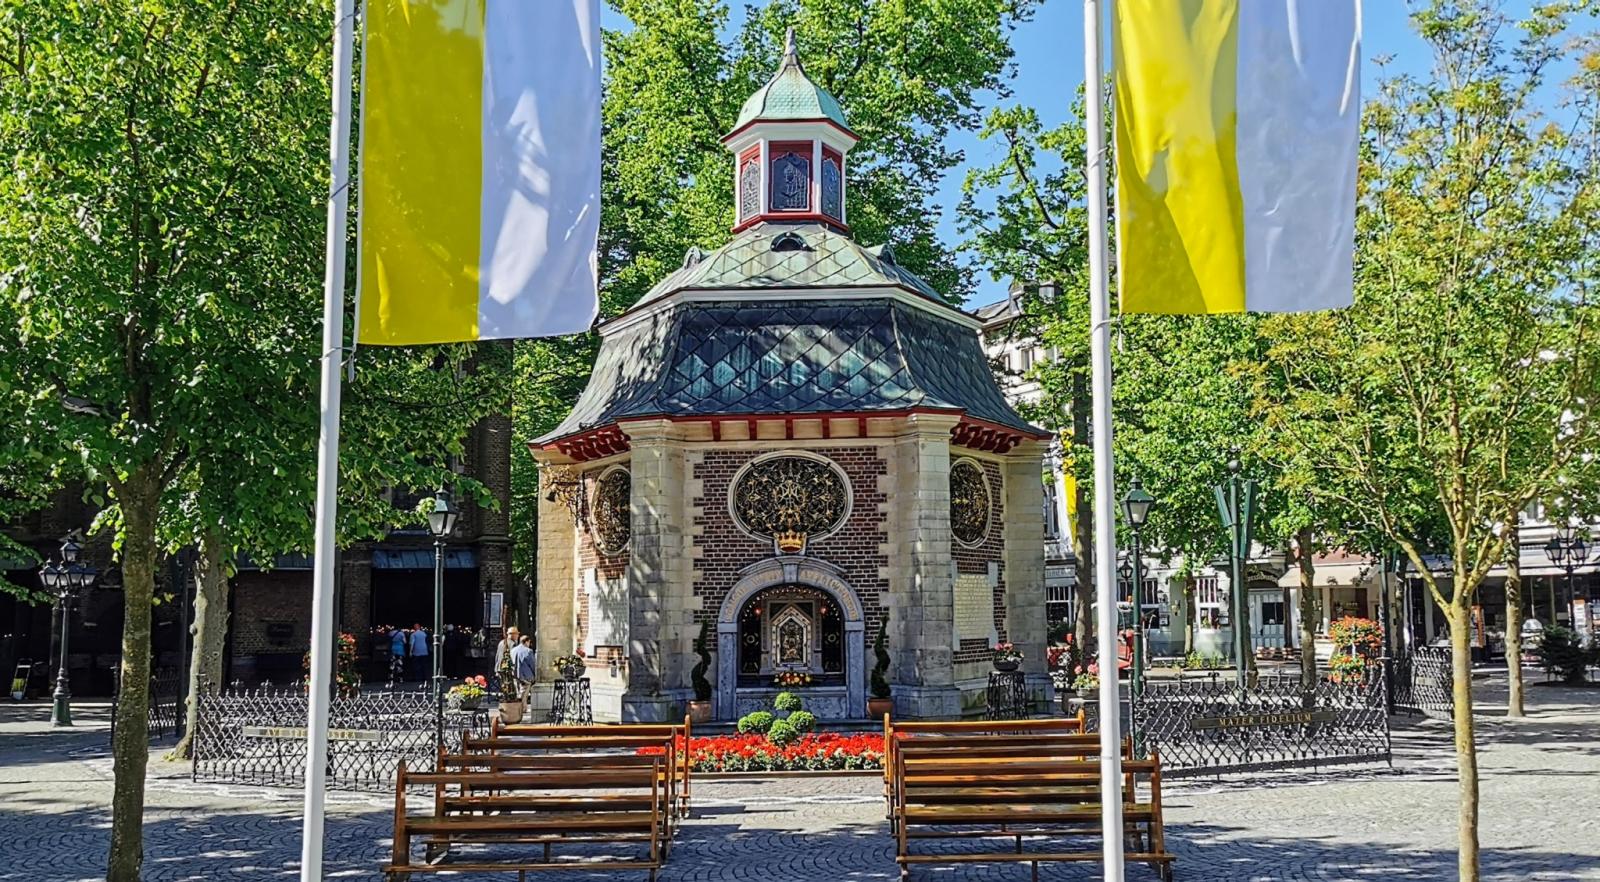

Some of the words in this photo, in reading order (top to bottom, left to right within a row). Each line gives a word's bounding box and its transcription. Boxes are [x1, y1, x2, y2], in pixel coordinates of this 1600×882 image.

[1219, 716, 1254, 726] MATER
[1259, 713, 1312, 723] FIDELIUM
[266, 728, 283, 737] AVE
[328, 730, 356, 739] STRA
